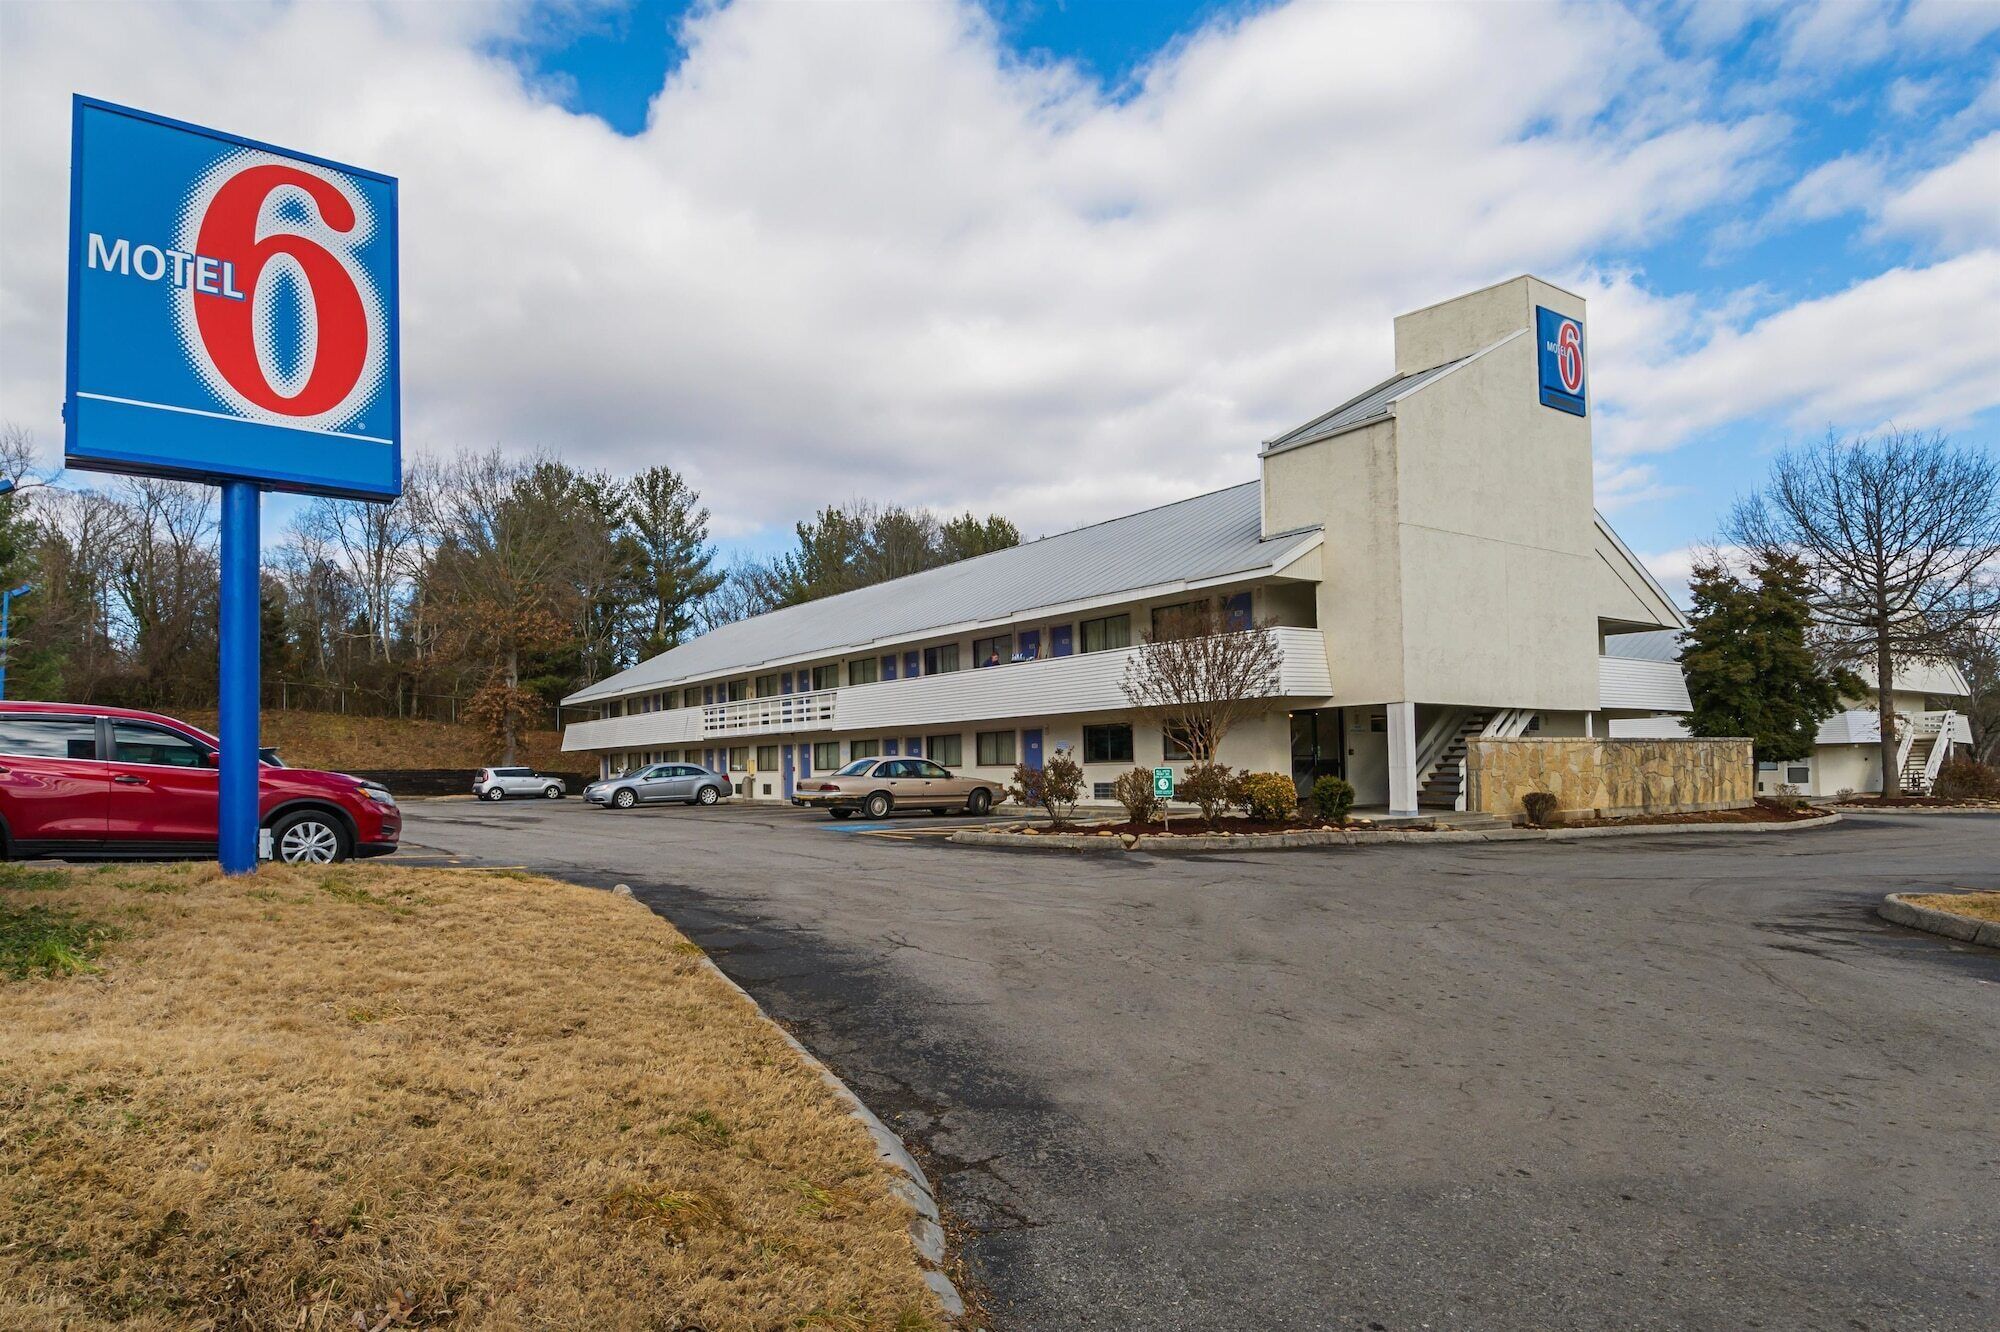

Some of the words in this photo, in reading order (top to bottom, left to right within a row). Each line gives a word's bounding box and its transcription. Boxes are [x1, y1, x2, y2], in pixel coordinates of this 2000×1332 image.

[87, 232, 245, 300] MOTEL
[194, 164, 368, 417] 6
[1546, 341, 1567, 357] MOTEL
[1560, 323, 1583, 390] 6
